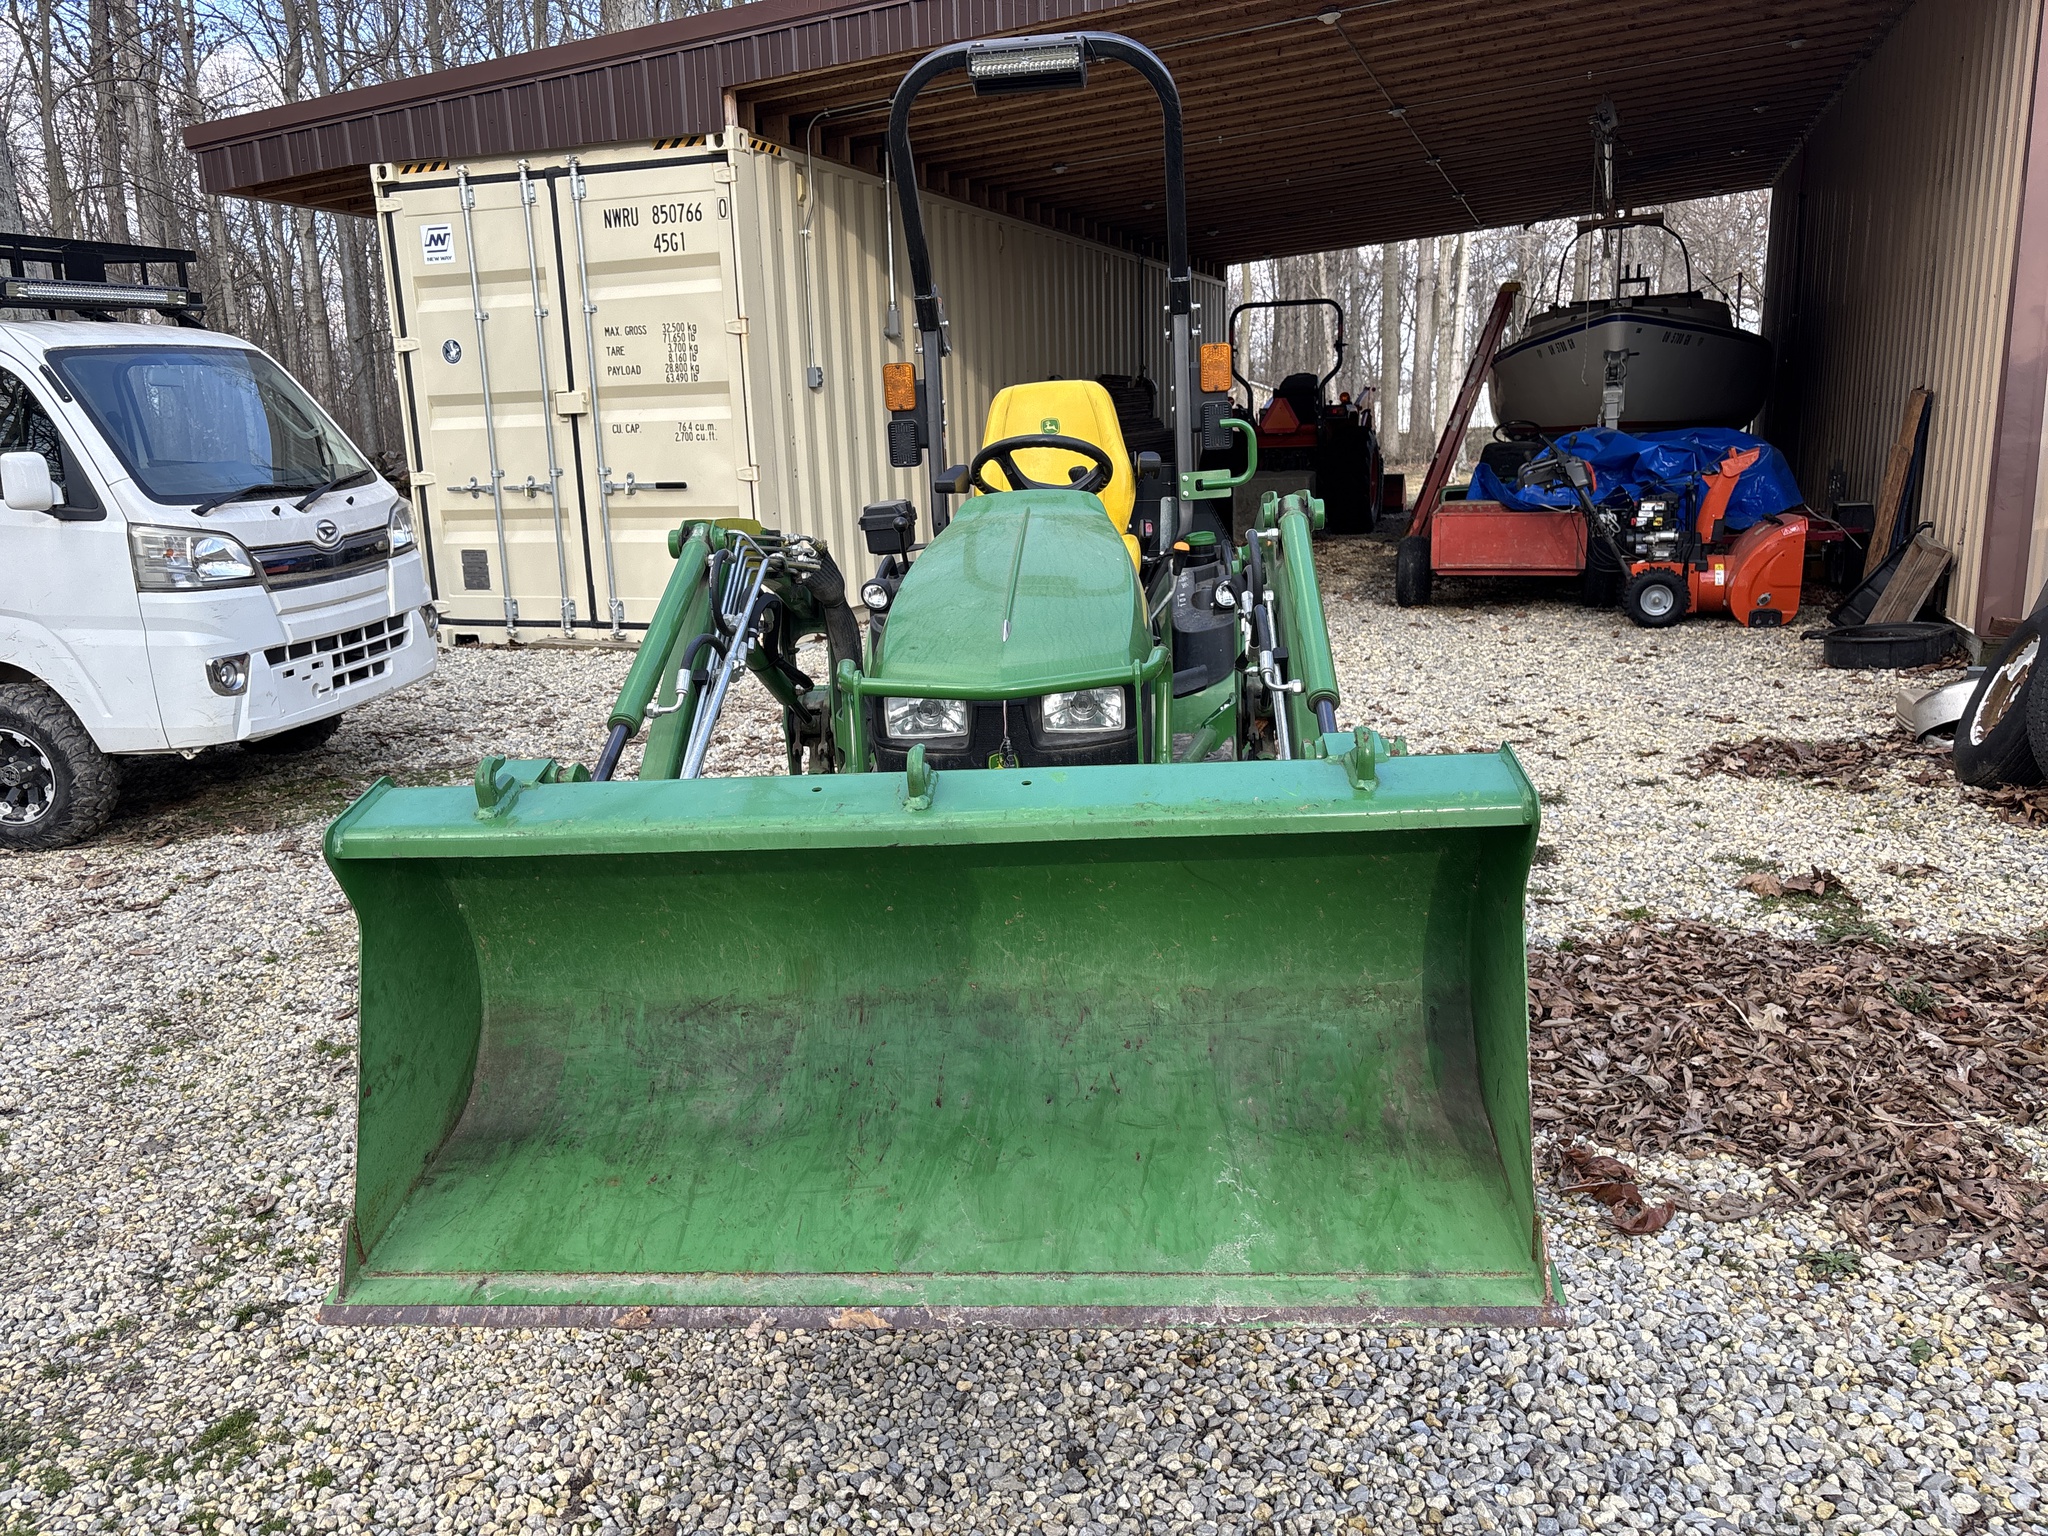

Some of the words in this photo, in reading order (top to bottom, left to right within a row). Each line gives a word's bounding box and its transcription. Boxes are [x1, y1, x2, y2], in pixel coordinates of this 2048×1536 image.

[603, 206, 639, 229] NWRU
[652, 202, 703, 225] 850766
[718, 198, 728, 219] 0
[653, 231, 686, 253] 45G1
[604, 326, 622, 336] MAX.
[624, 325, 647, 336] GROSS
[662, 322, 685, 333] 32.500
[687, 322, 697, 334] kg
[688, 332, 696, 342] lb
[606, 345, 625, 356] TARE
[689, 343, 699, 354] kg
[689, 352, 697, 362] lb
[607, 364, 642, 376] PAYLOAD
[690, 363, 700, 375] kg
[690, 373, 699, 382] lb
[625, 423, 642, 434] CAP.
[678, 421, 693, 432] 76.4
